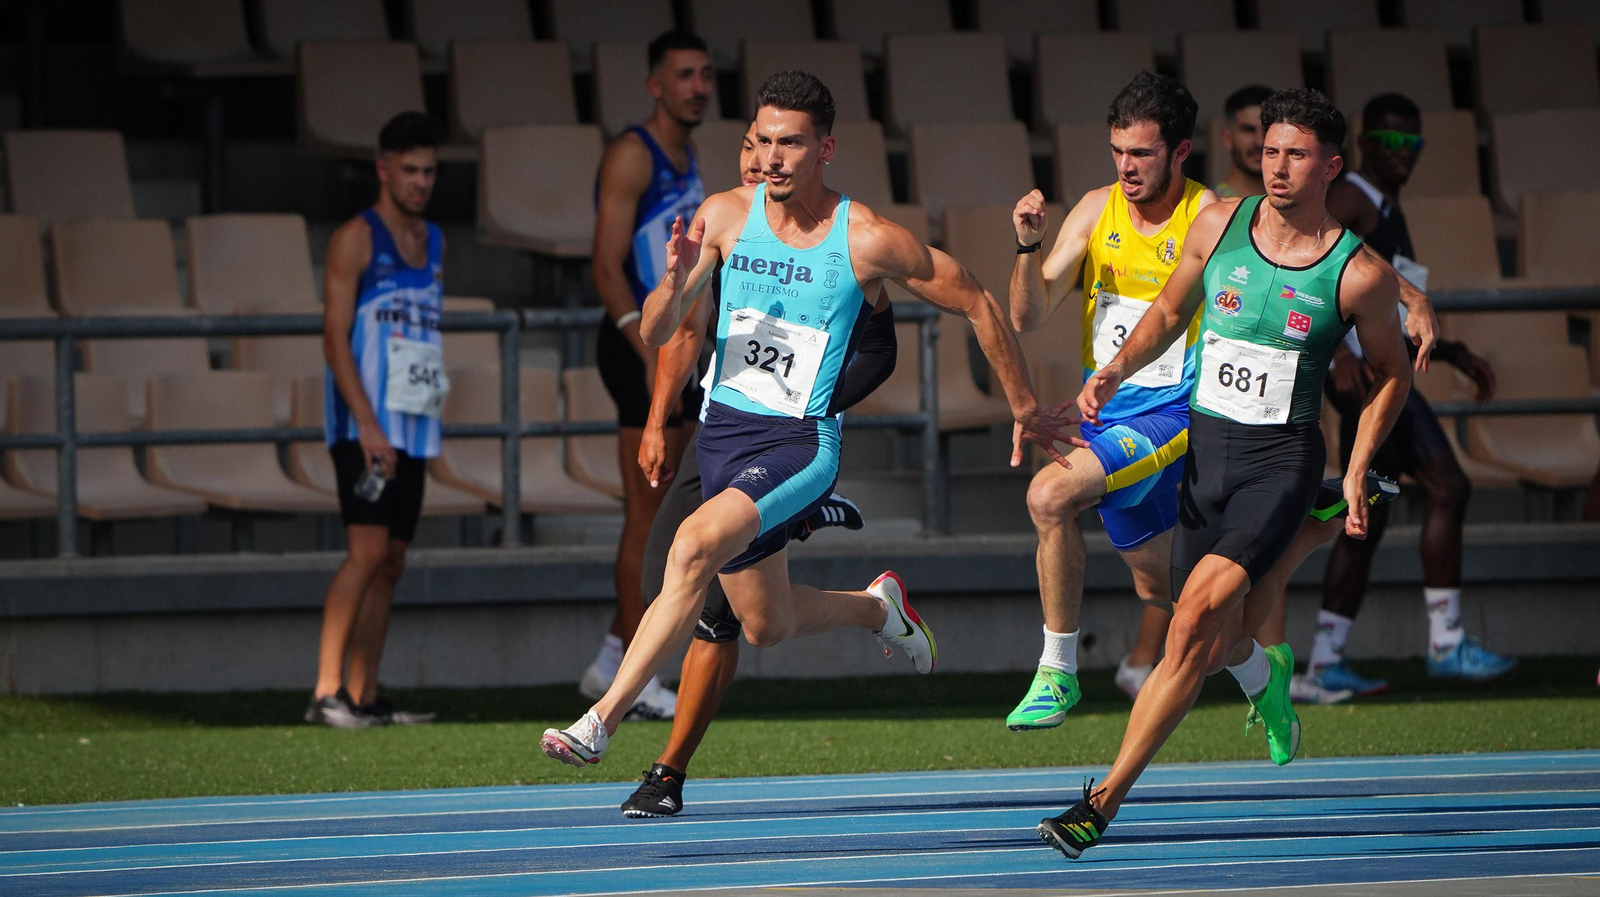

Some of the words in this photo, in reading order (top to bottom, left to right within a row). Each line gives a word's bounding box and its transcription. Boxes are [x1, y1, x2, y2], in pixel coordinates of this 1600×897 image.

[731, 253, 814, 285] nerja
[738, 280, 799, 299] ATLETISMO
[744, 339, 795, 379] 321
[1218, 362, 1269, 398] 681
